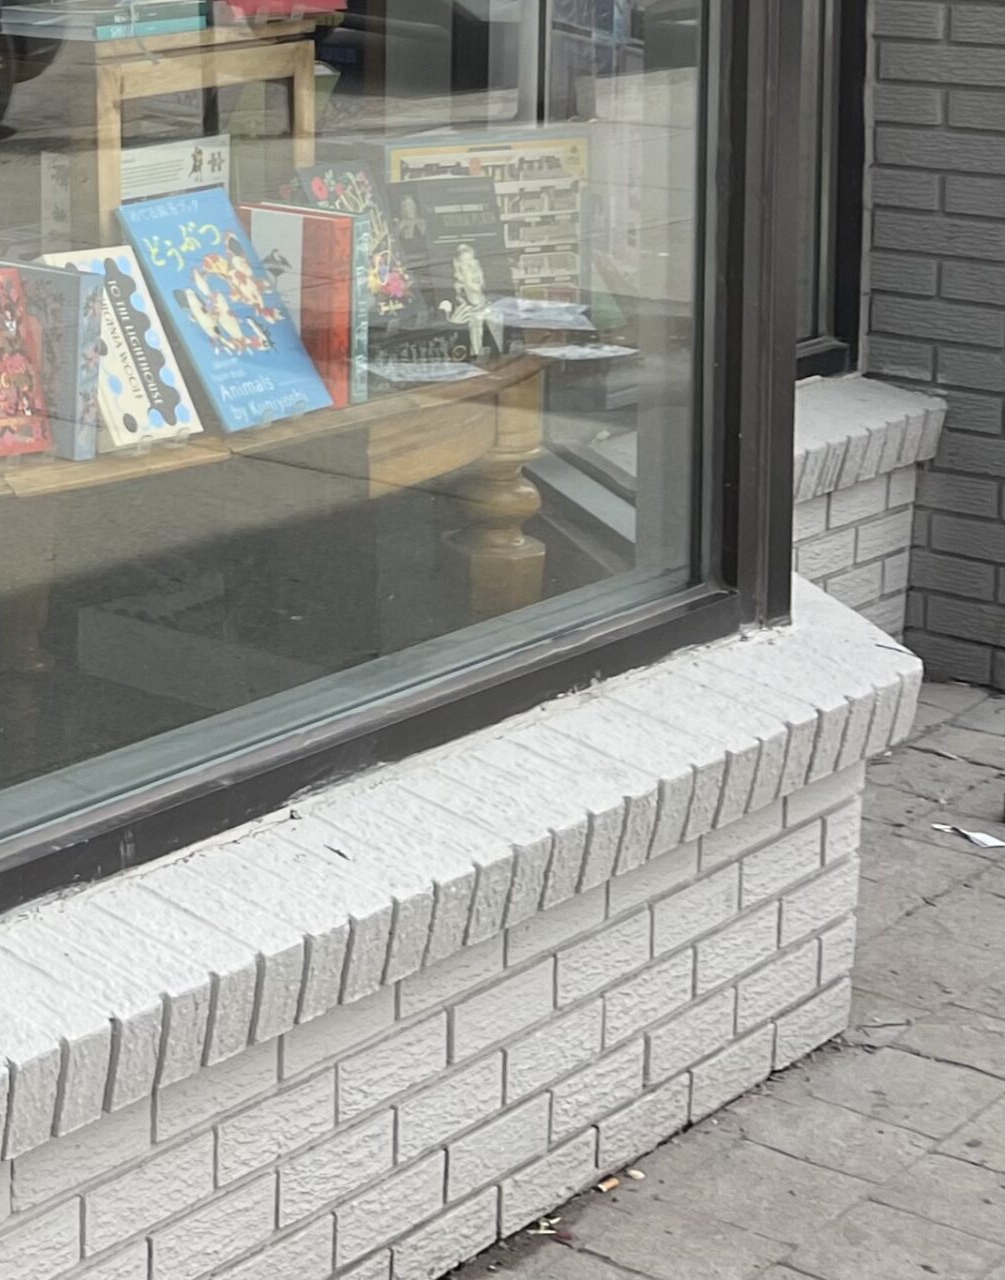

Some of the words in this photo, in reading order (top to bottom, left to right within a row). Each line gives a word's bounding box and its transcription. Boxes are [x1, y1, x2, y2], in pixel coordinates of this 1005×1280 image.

[142, 220, 221, 272] どうぶつ
[107, 280, 122, 298] TO
[115, 301, 130, 321] THE
[125, 325, 164, 405] LIGHTHOUSE
[119, 349, 144, 400] WOOLF
[219, 375, 275, 402] Animals
[230, 404, 248, 422] by
